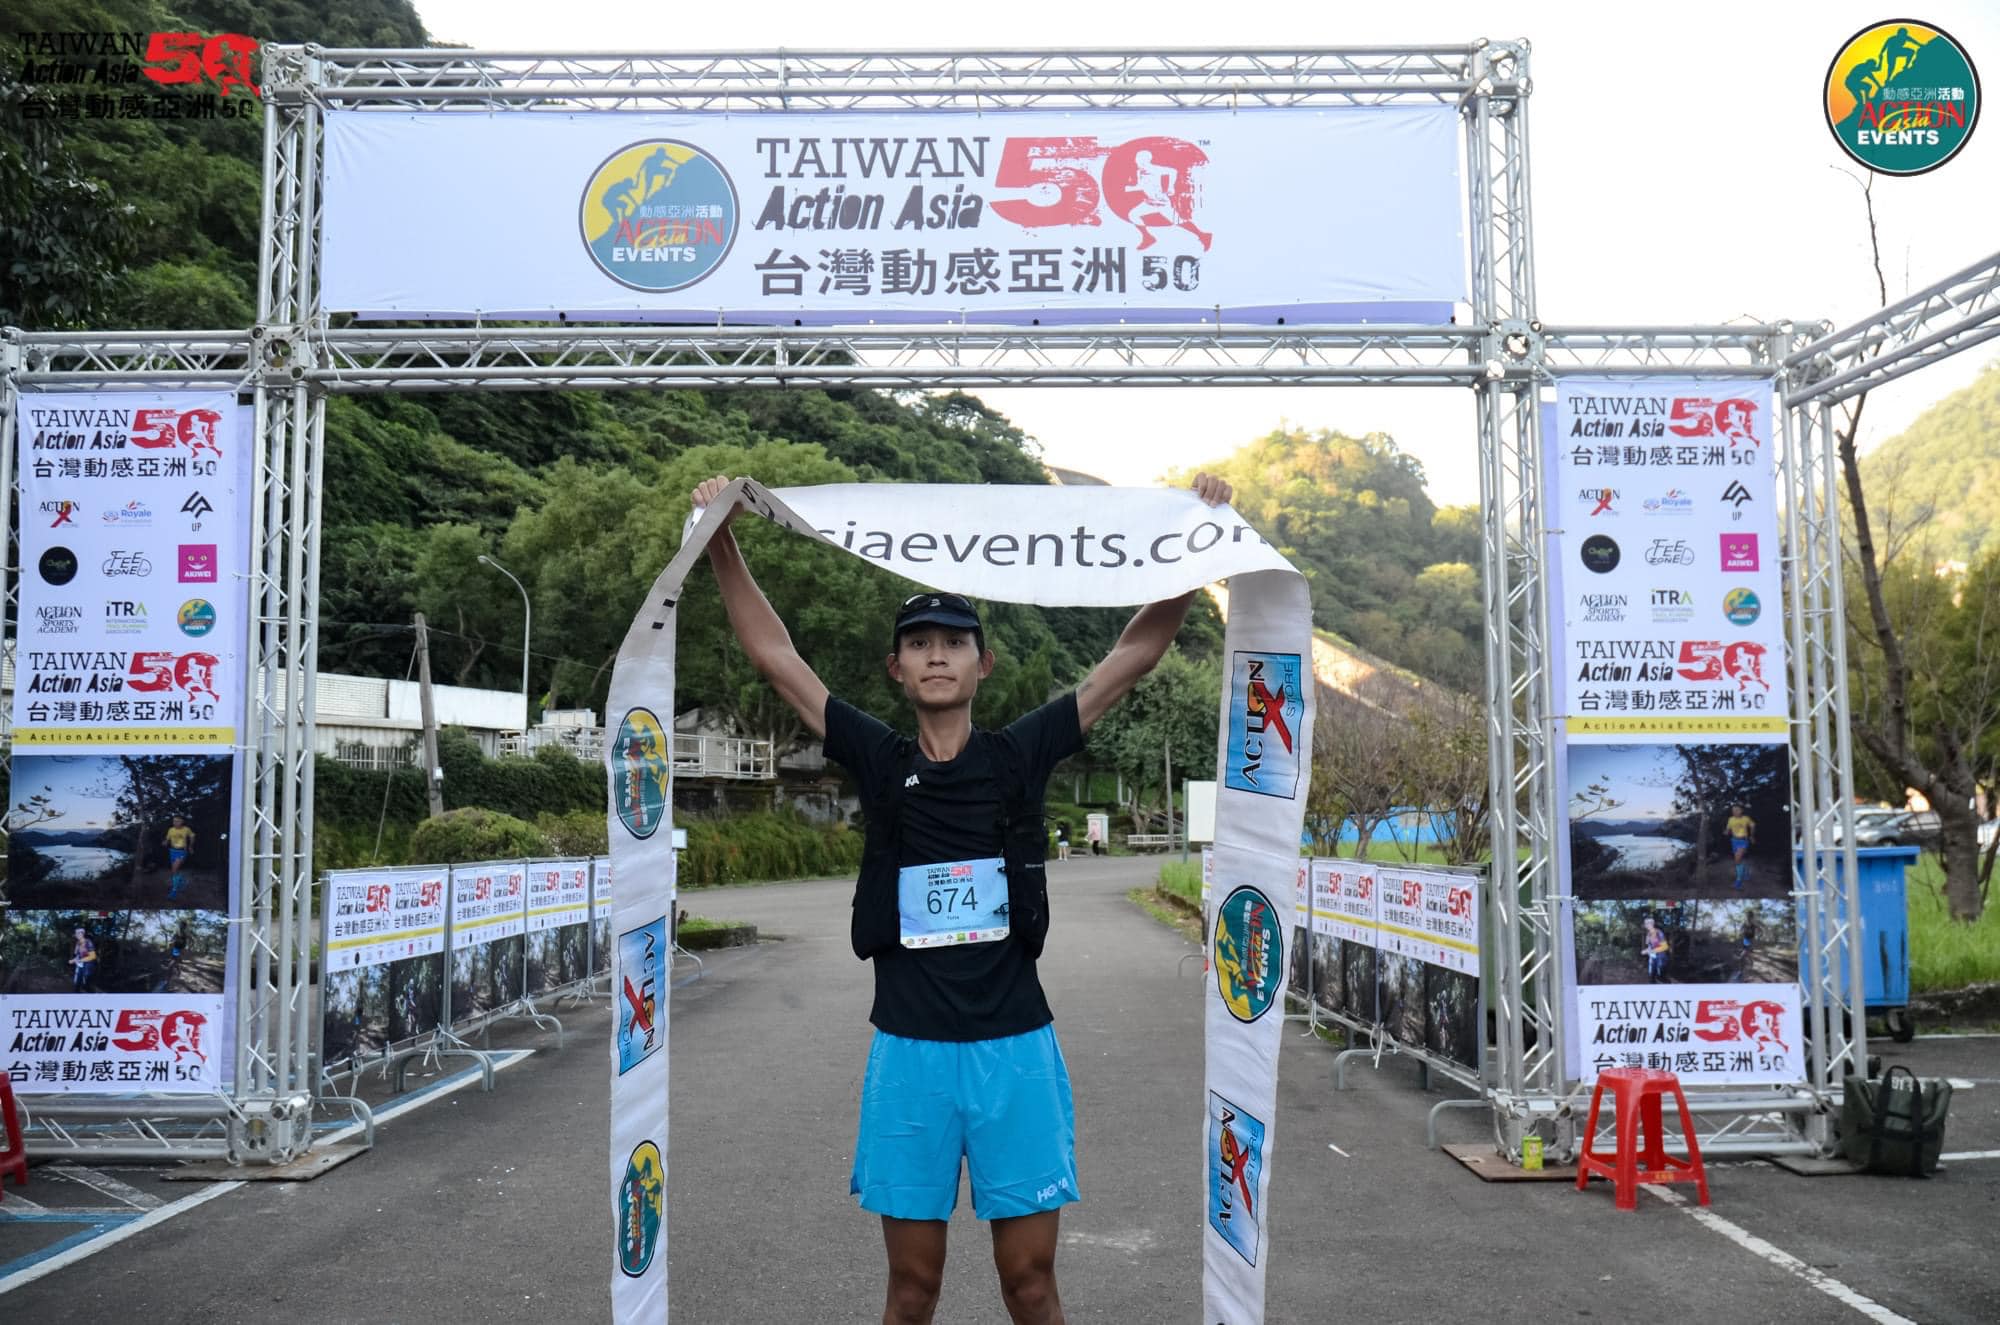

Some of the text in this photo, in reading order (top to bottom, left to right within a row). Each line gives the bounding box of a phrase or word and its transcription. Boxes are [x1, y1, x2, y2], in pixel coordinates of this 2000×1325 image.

[754, 183, 984, 231] Action Asia
[756, 137, 990, 178] TAIWAN
[989, 136, 1212, 252] 50
[613, 217, 724, 246] ACTION
[612, 247, 696, 262] EVENTS
[754, 247, 1200, 296] 台灣動感亞洲 50
[32, 408, 223, 459] TAIWAN 50
[1569, 396, 1760, 448] TAIWAN 50
[1570, 418, 1665, 438] Action Asia
[33, 430, 127, 450] Action Asia
[32, 457, 186, 478] 台灣動感亞洲
[1570, 445, 1725, 466] 台灣動感亞洲
[818, 520, 1267, 568] iaevents.co
[29, 652, 220, 702] TAIWAN 50
[1576, 640, 1770, 692] TAIWAN 50
[1578, 662, 1673, 682] Action Asia
[28, 673, 123, 693] Action Asia
[1283, 662, 1296, 717] STORE
[27, 701, 183, 722] 台灣動感亞洲
[1578, 690, 1735, 711] 台灣動感亞洲
[927, 886, 978, 914] 674
[1256, 928, 1271, 1002] EVENTS
[12, 1009, 207, 1063] TAIWAN 50
[1591, 1000, 1789, 1052] TAIWAN 50
[1592, 1022, 1690, 1044] Action Asia
[9, 1031, 108, 1053] Action Asia
[8, 1060, 169, 1081] 台灣動感亞洲
